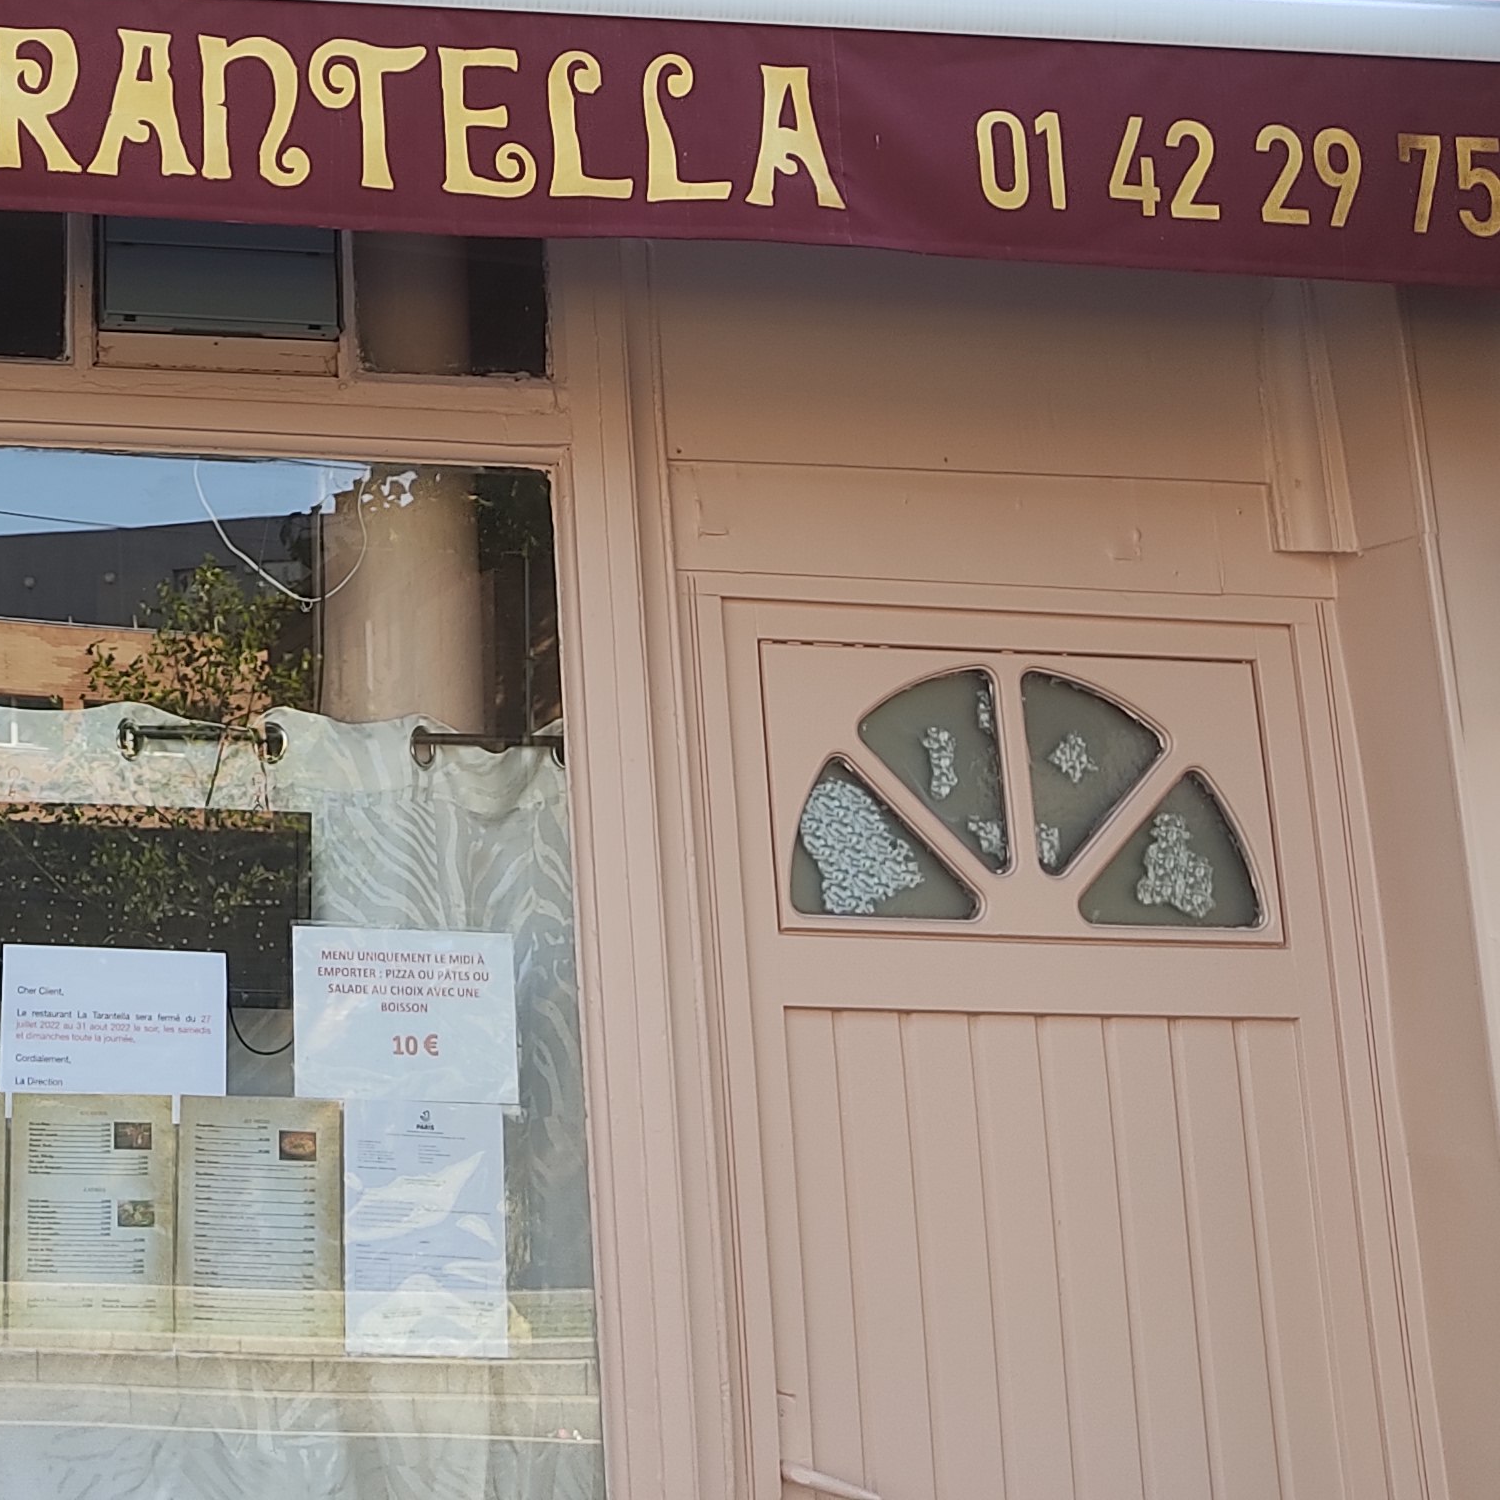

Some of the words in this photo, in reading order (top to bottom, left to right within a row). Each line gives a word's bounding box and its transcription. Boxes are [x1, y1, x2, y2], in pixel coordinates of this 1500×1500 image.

[976, 109, 1067, 211] 01
[1108, 116, 1221, 220] 42
[1255, 123, 1362, 228] 29
[1397, 133, 1500, 238] 75
[321, 950, 355, 961] MENU
[357, 951, 431, 965] UNIQUEMENT
[434, 953, 446, 964] LE
[449, 954, 474, 965] MIDI
[477, 951, 485, 965] À
[317, 967, 376, 978] EMPORTER
[385, 969, 414, 979] PIZZA
[418, 969, 434, 980] OU
[473, 971, 489, 981] OU
[17, 985, 36, 995] Cher
[328, 984, 369, 995] SALADE
[371, 985, 387, 995] AU
[390, 985, 424, 996] CHOIX
[426, 987, 455, 997] AVEC
[457, 988, 480, 998] UNE
[381, 1002, 428, 1013] BOISSON
[17, 1008, 27, 1018] Le
[31, 1009, 72, 1019] restaurant
[77, 1010, 88, 1019] La
[92, 1010, 130, 1020] Tarantella
[185, 1014, 196, 1023] du
[39, 1021, 60, 1030] 2022
[76, 1022, 86, 1031] 31
[110, 1023, 130, 1032] 2022
[26, 1032, 70, 1041] dimanches
[71, 1033, 93, 1041] toute
[392, 1035, 418, 1056] 10
[423, 1033, 440, 1057] €
[14, 1077, 25, 1085] La
[27, 1077, 63, 1086] Direction
